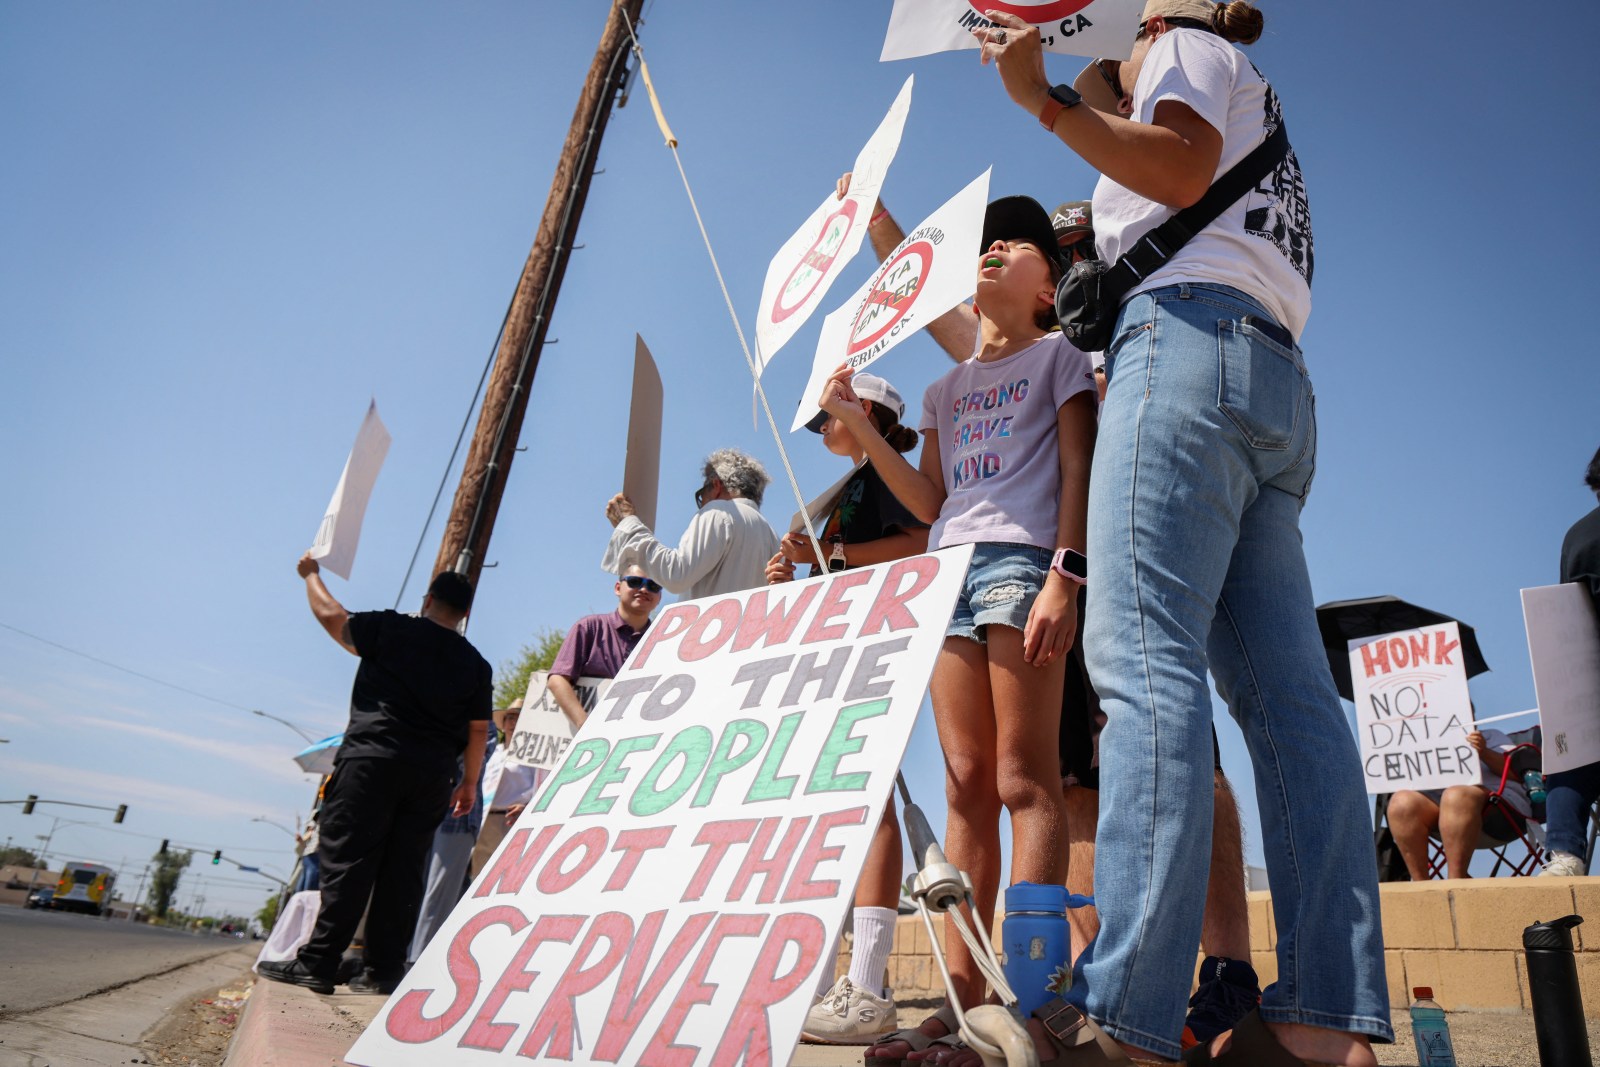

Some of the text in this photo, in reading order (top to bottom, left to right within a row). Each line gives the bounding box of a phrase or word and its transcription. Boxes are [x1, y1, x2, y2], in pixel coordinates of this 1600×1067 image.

[1059, 13, 1093, 37] CA
[845, 338, 890, 369] PERIAL
[953, 378, 1030, 423] STRONG
[953, 415, 1015, 454] BRAVE
[953, 453, 1002, 489] KIND
[629, 556, 941, 670] POWER
[1360, 631, 1460, 678] HONK
[604, 673, 696, 722] TO
[731, 635, 912, 711] THE
[1370, 682, 1427, 719] NO!
[507, 731, 572, 765] ENTERS
[1369, 714, 1468, 749] DATA
[532, 697, 893, 818] PEOPLE
[1365, 745, 1473, 781] CENTER
[473, 805, 870, 904] NOT THE
[386, 905, 827, 1067] SERVER
